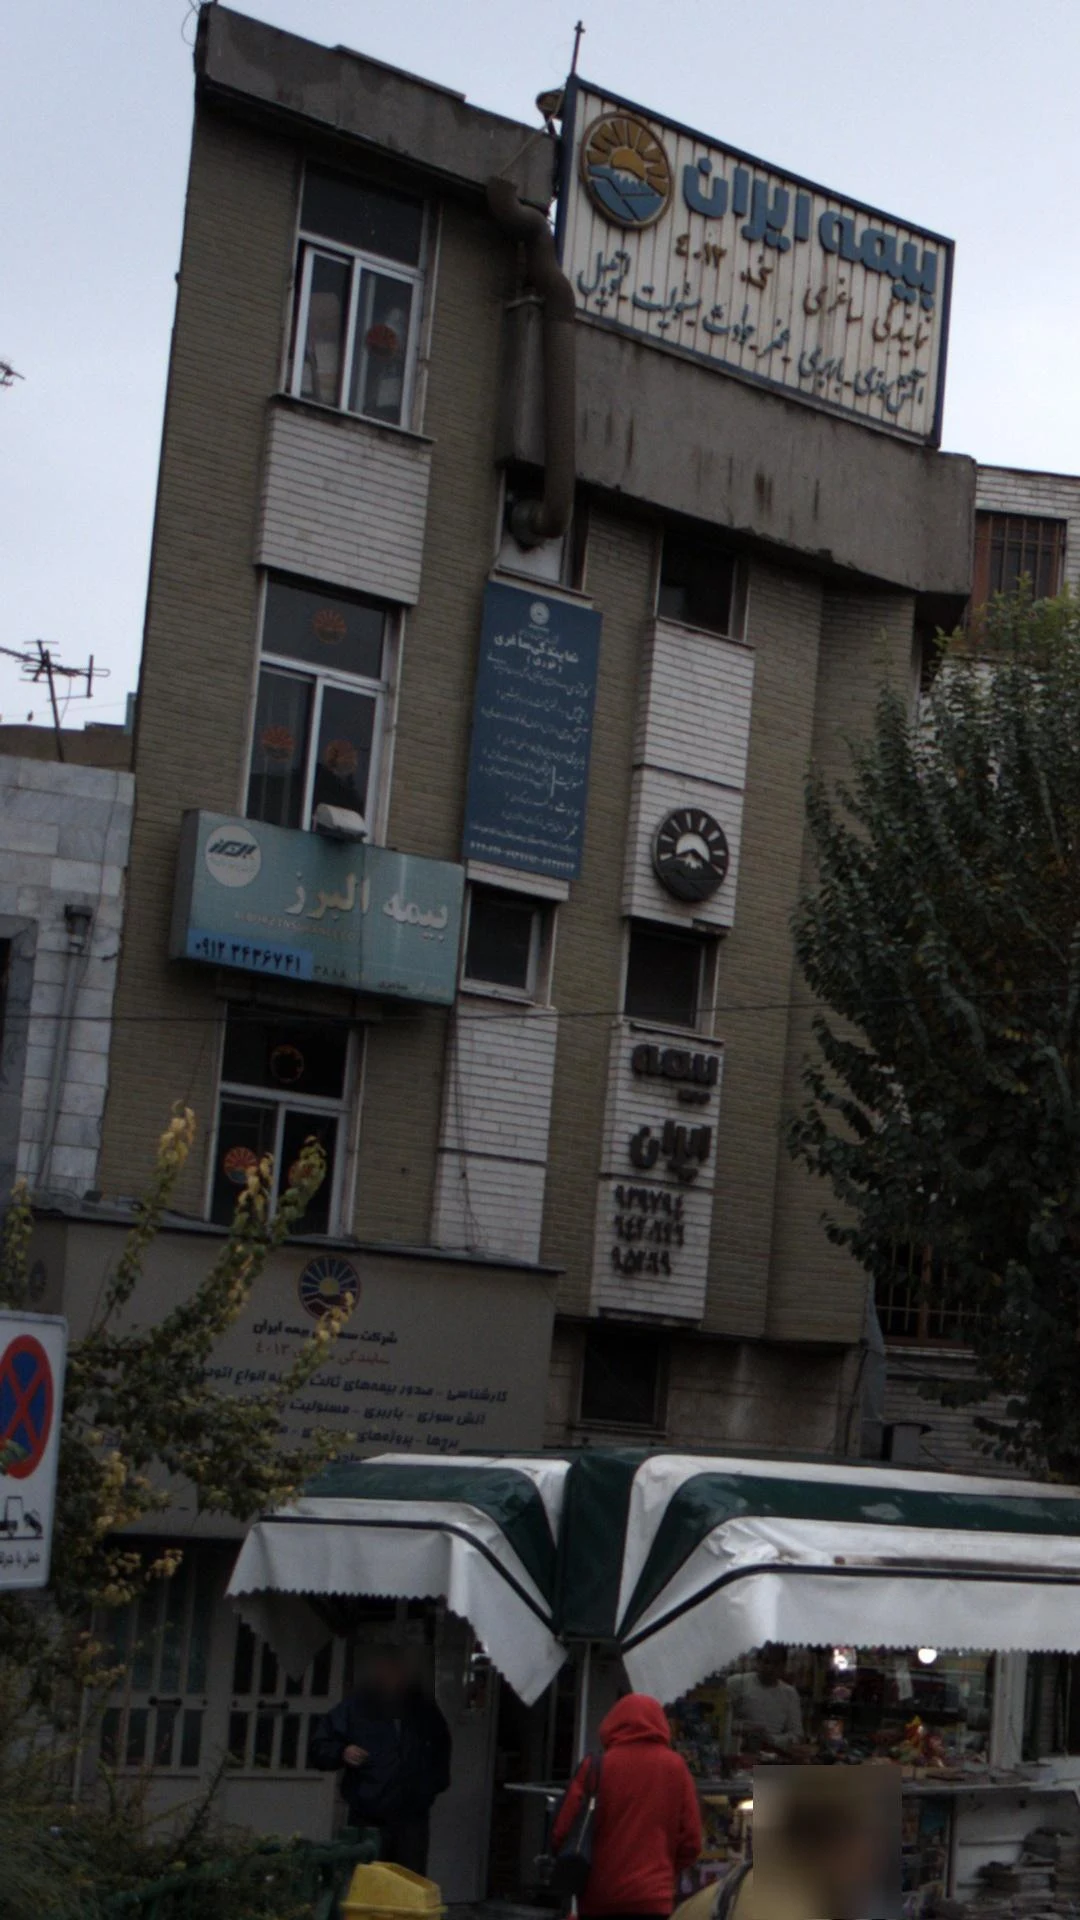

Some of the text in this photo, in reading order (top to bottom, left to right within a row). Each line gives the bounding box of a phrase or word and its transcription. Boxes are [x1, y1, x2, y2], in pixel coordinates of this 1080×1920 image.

[682, 157, 938, 313] بیمه ایران
[872, 298, 932, 357] نمایندگی
[284, 871, 448, 943] بیمه البرز
[630, 1043, 719, 1105] بیمه
[628, 1119, 712, 1184] ایران
[253, 1319, 283, 1335] ایران
[360, 1329, 398, 1346] شرکت
[231, 1369, 267, 1385] انواع
[309, 1374, 342, 1388] ثالث
[400, 1384, 434, 1396] صدور
[446, 1388, 508, 1403] کارشناسی
[364, 1404, 403, 1421] باربری
[417, 1411, 453, 1424] سوزی
